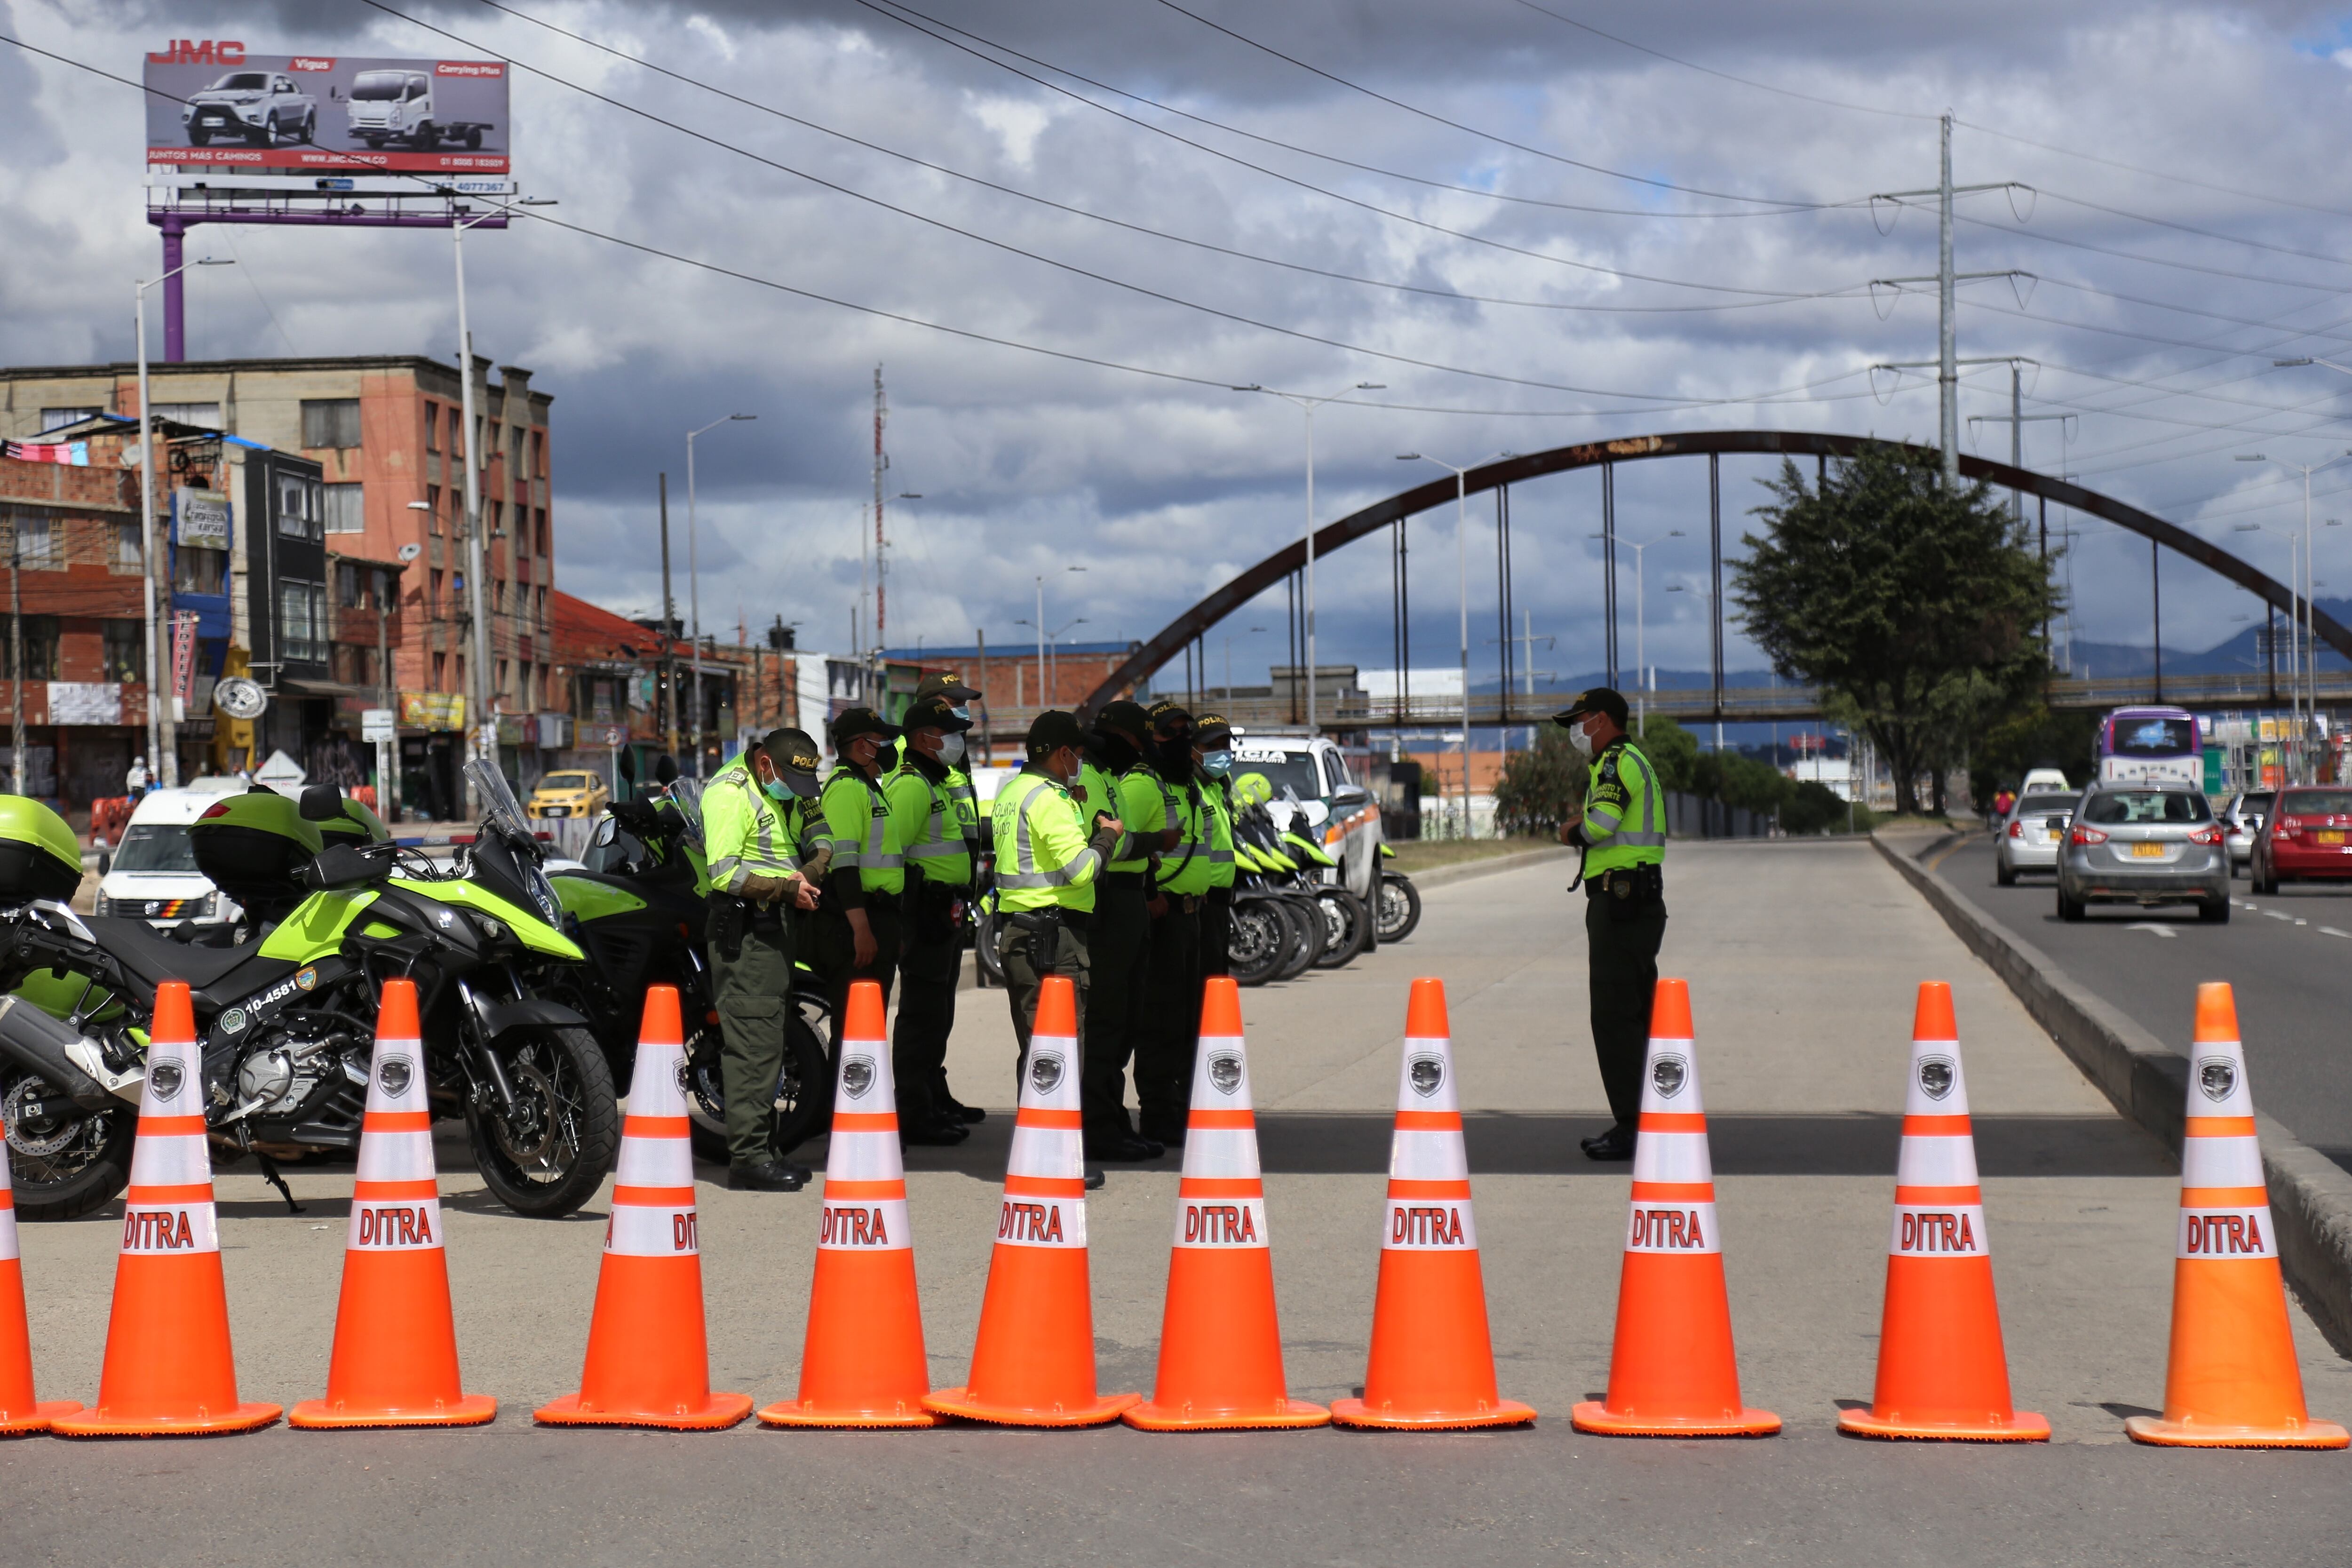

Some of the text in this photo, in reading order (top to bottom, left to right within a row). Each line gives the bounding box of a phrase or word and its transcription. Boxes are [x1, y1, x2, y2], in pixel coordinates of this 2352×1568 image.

[148, 40, 245, 65] JMC
[295, 58, 329, 71] Vigus
[438, 64, 501, 75] Carrying Plus
[148, 151, 187, 159] JUNTOS
[215, 152, 262, 161] CAMINOS
[457, 182, 504, 191] 4077367
[1231, 750, 1287, 760] ICIA
[245, 979, 297, 1014] 10-4581
[123, 1211, 195, 1250] DITRA
[359, 1207, 432, 1246] DITRA
[821, 1208, 888, 1245] DITRA
[998, 1202, 1064, 1242] DITRA
[1185, 1206, 1256, 1243] DITRA
[1392, 1207, 1465, 1245] DITRA
[1632, 1210, 1705, 1248] DITRA
[1901, 1213, 1977, 1252] DITRA
[2188, 1215, 2265, 1254] DITRA
